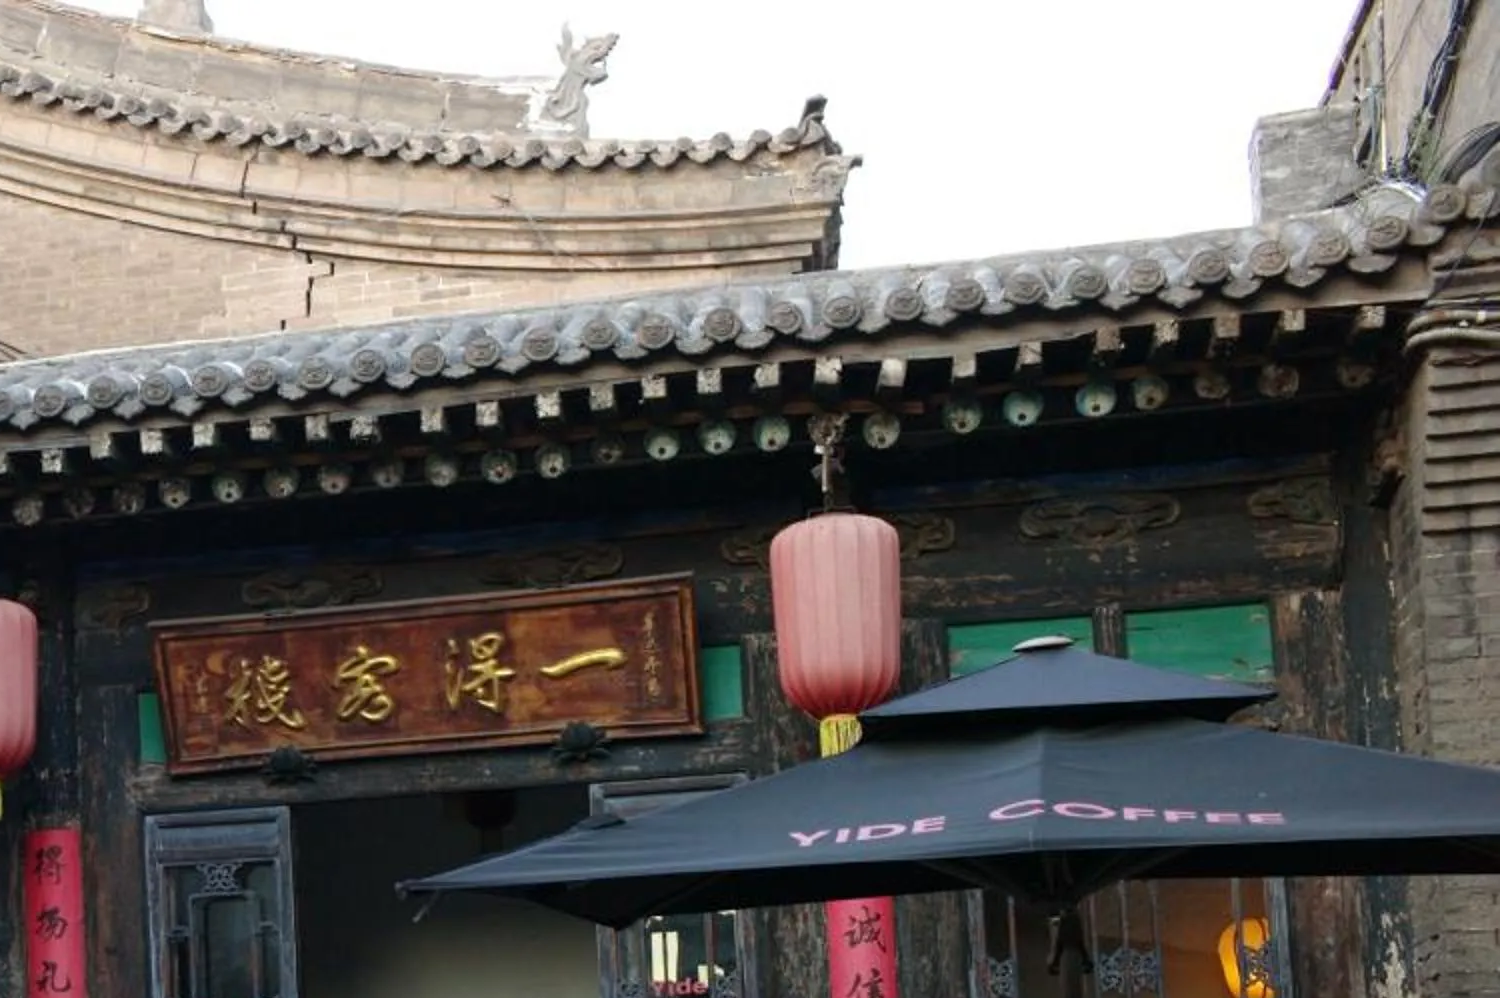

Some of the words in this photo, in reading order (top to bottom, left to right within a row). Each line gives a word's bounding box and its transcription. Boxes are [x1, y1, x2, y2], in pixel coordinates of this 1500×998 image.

[789, 815, 946, 848] YIDE
[987, 799, 1287, 826] COFFEE
[651, 977, 708, 996] Yide
